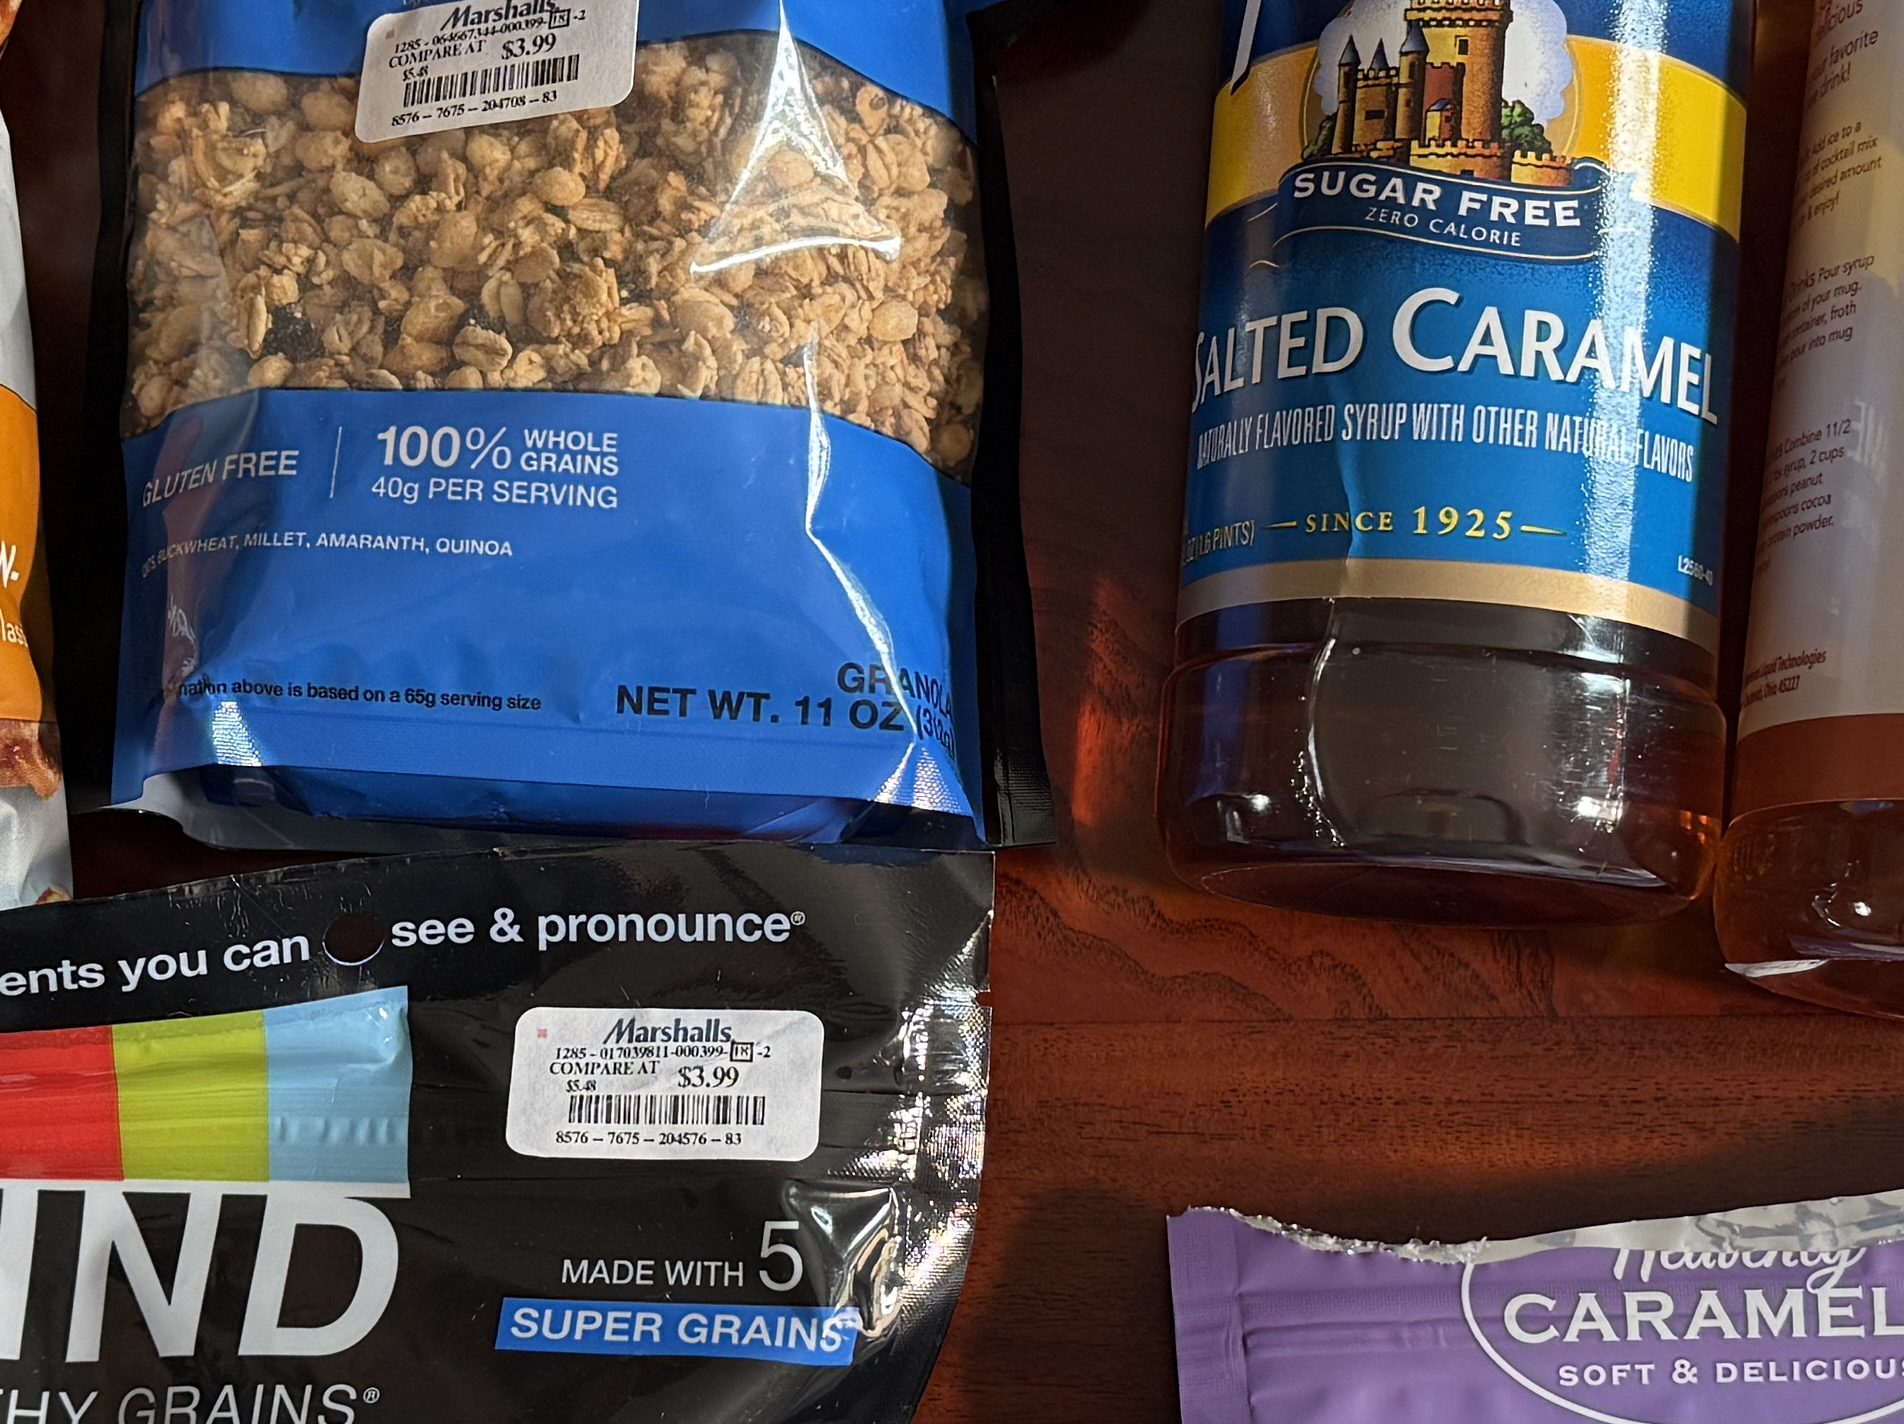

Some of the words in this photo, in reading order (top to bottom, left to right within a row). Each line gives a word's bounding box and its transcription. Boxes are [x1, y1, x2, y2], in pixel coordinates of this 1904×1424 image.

[1293, 172, 1438, 211] SUGAR
[1457, 190, 1581, 228] FREE
[1365, 206, 1417, 228] ZERO
[1430, 217, 1521, 247] CALORIE
[1392, 286, 1718, 425] CARAMEL
[244, 532, 310, 549] MILLET,
[316, 534, 429, 555] AMARANTH,
[436, 539, 513, 556] QUINOA
[118, 953, 210, 992] you
[221, 930, 310, 972] can
[391, 916, 475, 950] see
[488, 909, 526, 944] &
[603, 1017, 732, 1044] Marshalls
[549, 1061, 634, 1075] COMPARE
[638, 1061, 660, 1074] AT
[678, 1066, 739, 1088] $3.99
[566, 1079, 596, 1093] $5.48
[556, 1131, 588, 1144] 8576
[608, 1132, 640, 1145] 7675
[659, 1132, 707, 1145] 204576
[725, 1132, 741, 1145] 83
[1558, 1362, 1655, 1387] SOFT
[1672, 1359, 1698, 1385] &
